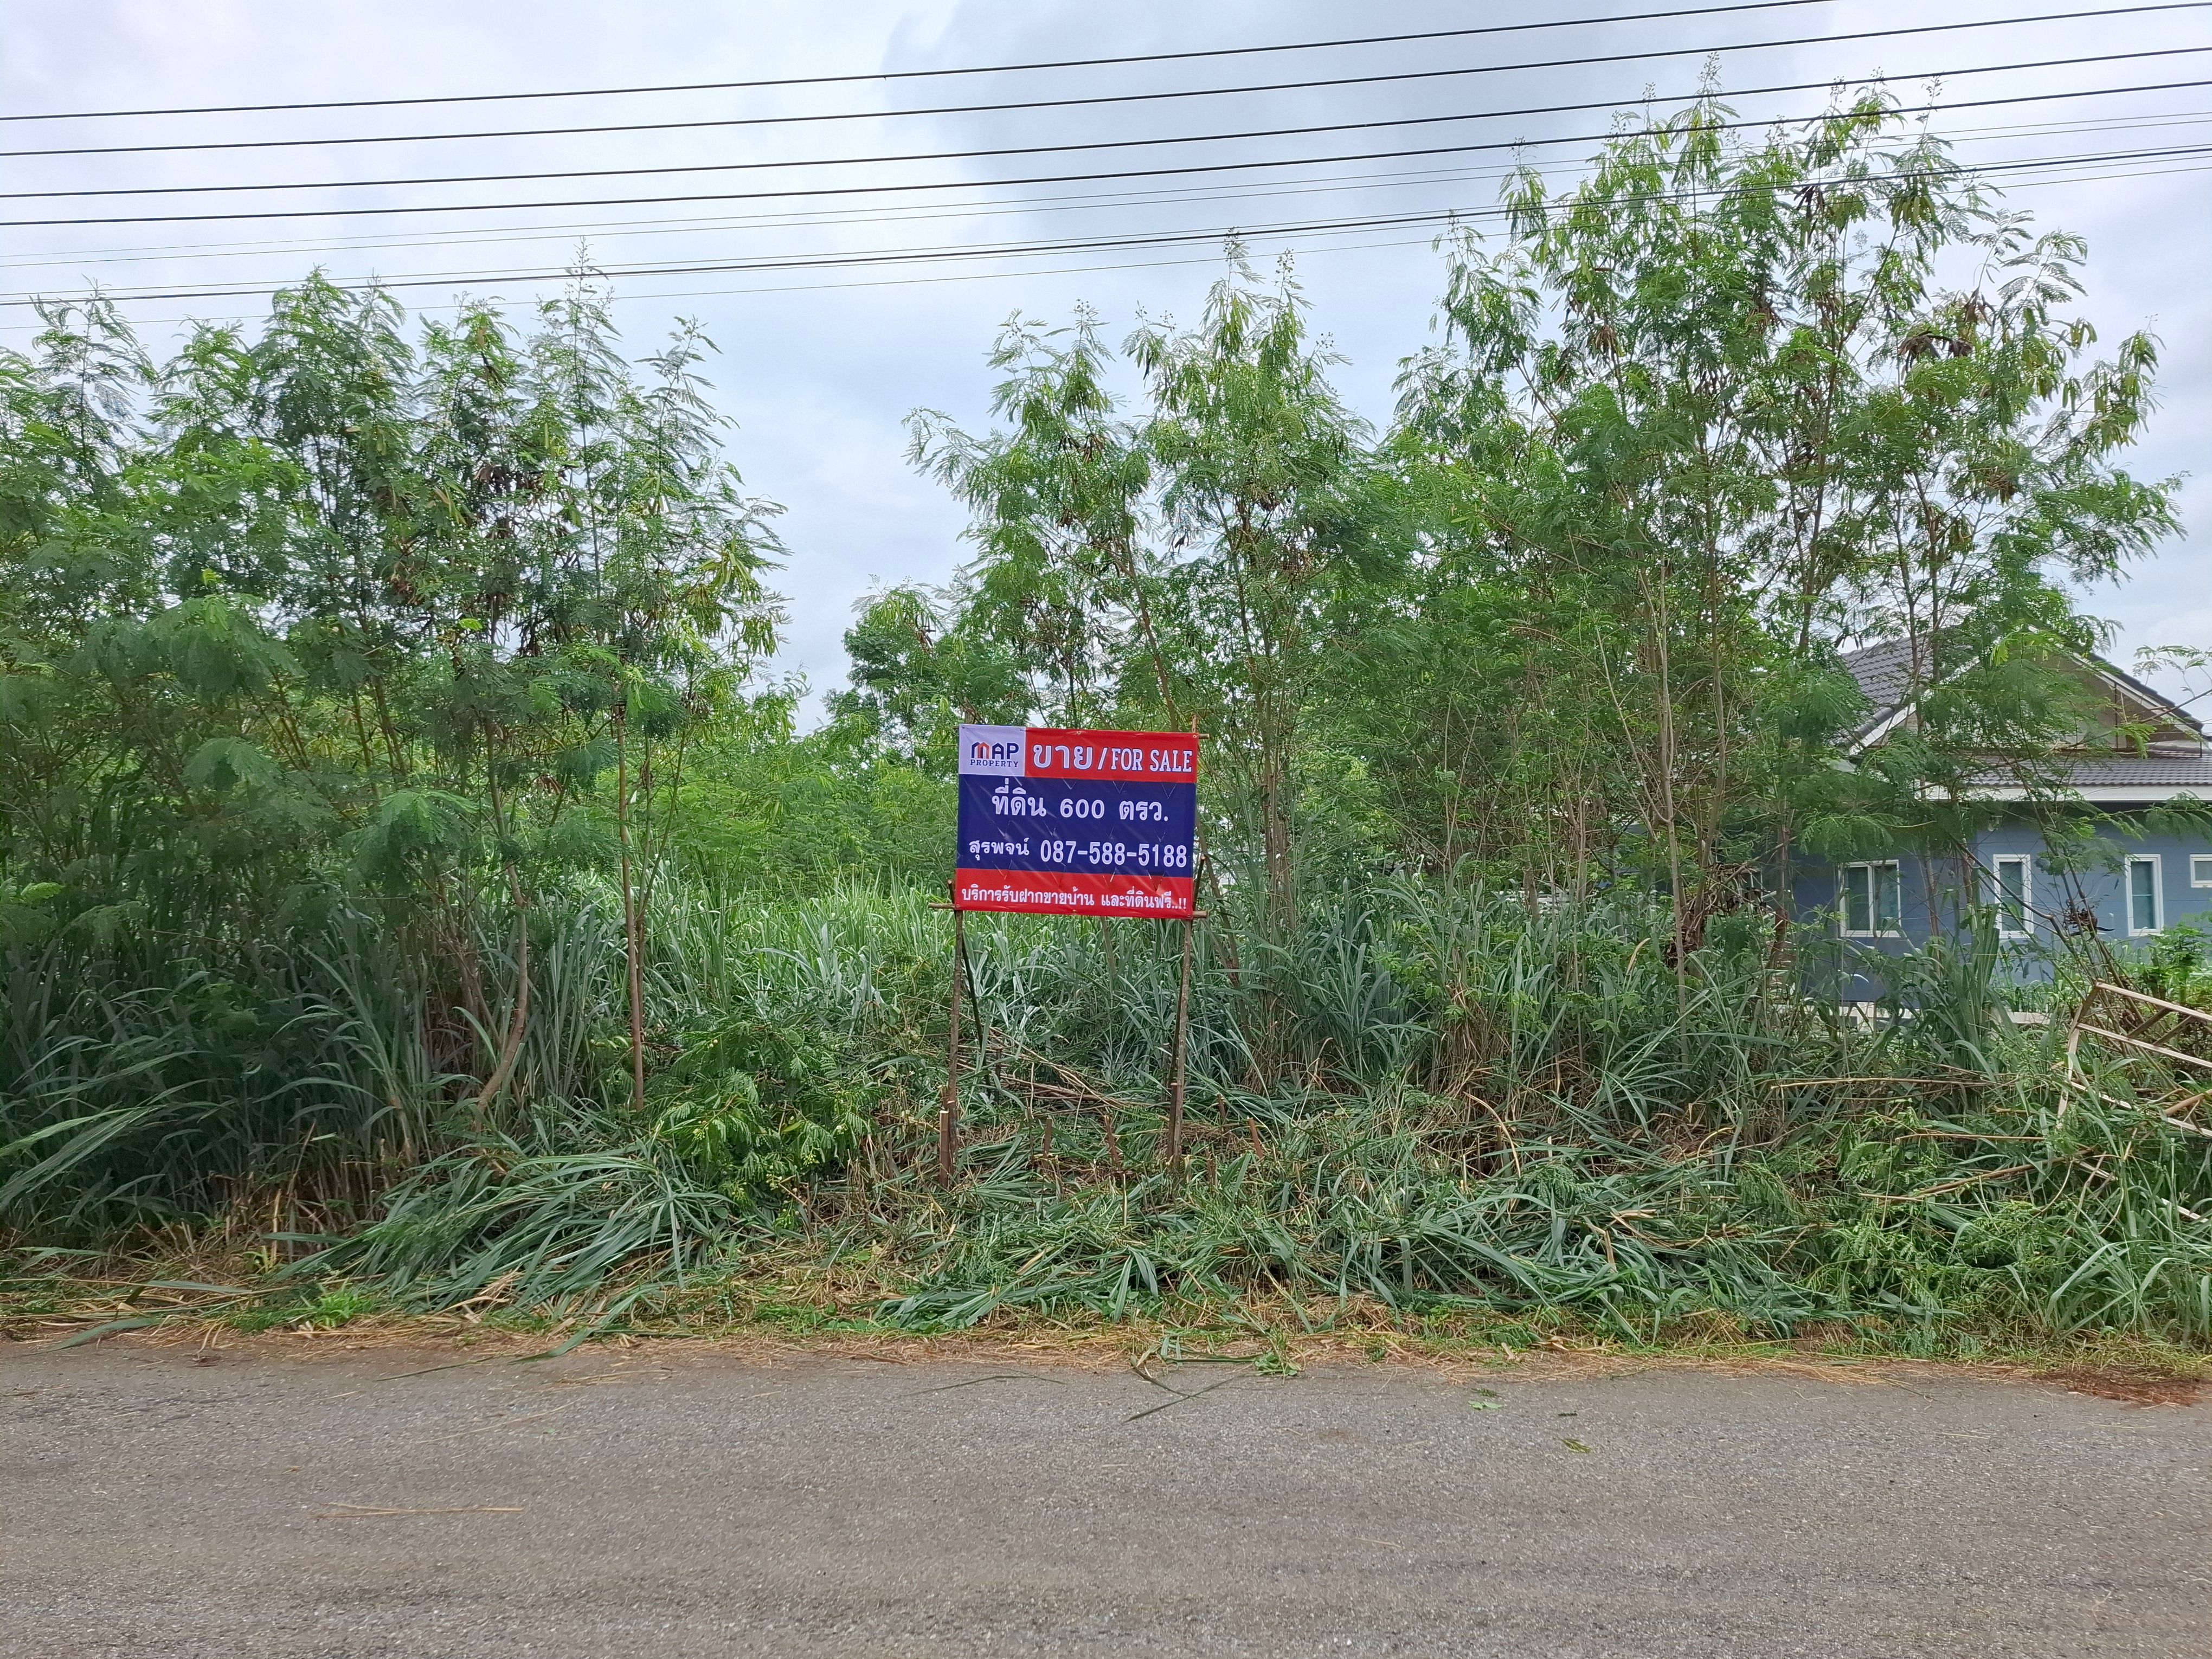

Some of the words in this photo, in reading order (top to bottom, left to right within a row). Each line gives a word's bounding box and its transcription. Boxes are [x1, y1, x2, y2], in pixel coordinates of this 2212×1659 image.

[971, 742, 1019, 760] MAP
[1149, 749, 1193, 772] SALE
[970, 759, 1019, 768] PROPERTY
[992, 777, 1047, 817] ที่ดิน
[1060, 798, 1105, 819] 600
[1119, 800, 1168, 821] ตรว.
[969, 837, 1030, 861] สุรพจน์
[1040, 839, 1187, 867] 087-588-5188
[962, 883, 1095, 906] บริการรับฝากขายบ้าน
